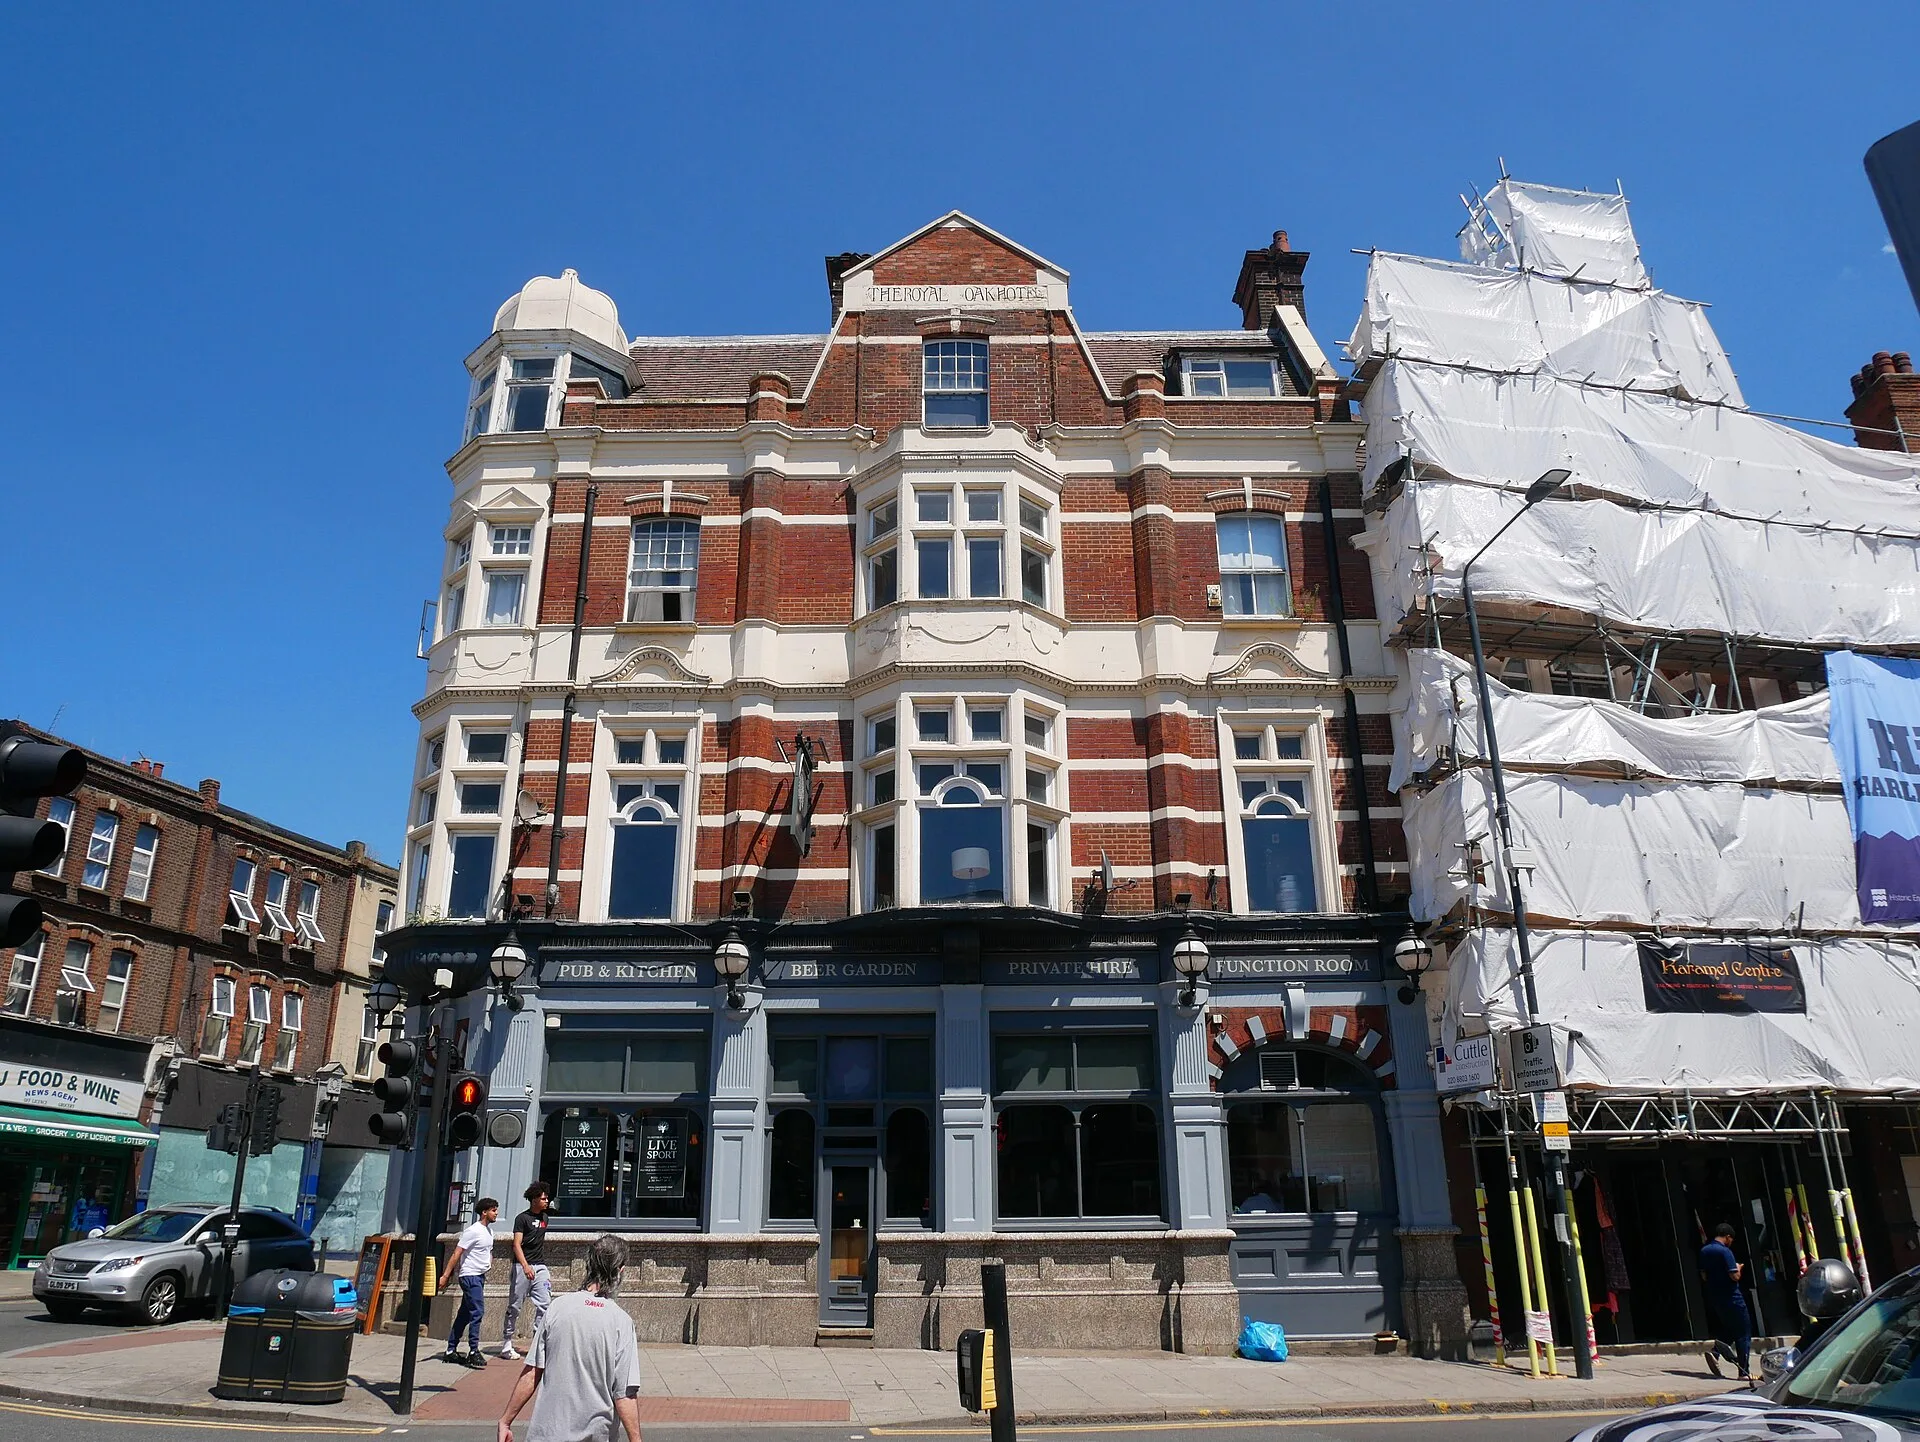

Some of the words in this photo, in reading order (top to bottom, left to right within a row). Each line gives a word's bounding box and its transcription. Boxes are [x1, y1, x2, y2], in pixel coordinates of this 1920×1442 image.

[904, 286, 949, 301] ROYAL
[964, 286, 996, 301] OAK
[559, 965, 594, 978] PUB
[598, 965, 611, 978] &
[615, 964, 697, 978] KITCHEN
[790, 964, 837, 977] BEER
[842, 963, 917, 977] GARDEN
[1008, 962, 1083, 975] PRIVATE
[1089, 961, 1133, 974] HIRE
[1215, 959, 1309, 973] FUNCTION
[1314, 958, 1370, 972] ROOM
[1660, 960, 1730, 981] Karamel
[1731, 961, 1784, 982] Centre
[1454, 1040, 1488, 1061] Cuttle
[1455, 1059, 1490, 1071] construction
[1523, 1057, 1543, 1068] Traffic
[1516, 1066, 1554, 1079] enforcement
[17, 1070, 63, 1088] FOOD
[66, 1075, 78, 1091] &
[83, 1078, 121, 1106] WINE
[1524, 1078, 1549, 1089] cameras
[25, 1089, 49, 1097] NEWS
[51, 1090, 79, 1104] AGENT
[12, 1125, 27, 1133] VEG
[36, 1128, 69, 1138] GROCERY
[76, 1132, 89, 1141] OFF
[89, 1133, 117, 1143] LICENCE
[123, 1137, 151, 1146] LOTTERY
[565, 1139, 602, 1148] SUNDAY
[647, 1140, 678, 1150] LIVE
[564, 1148, 602, 1158] ROAST
[646, 1150, 678, 1160] SPORT
